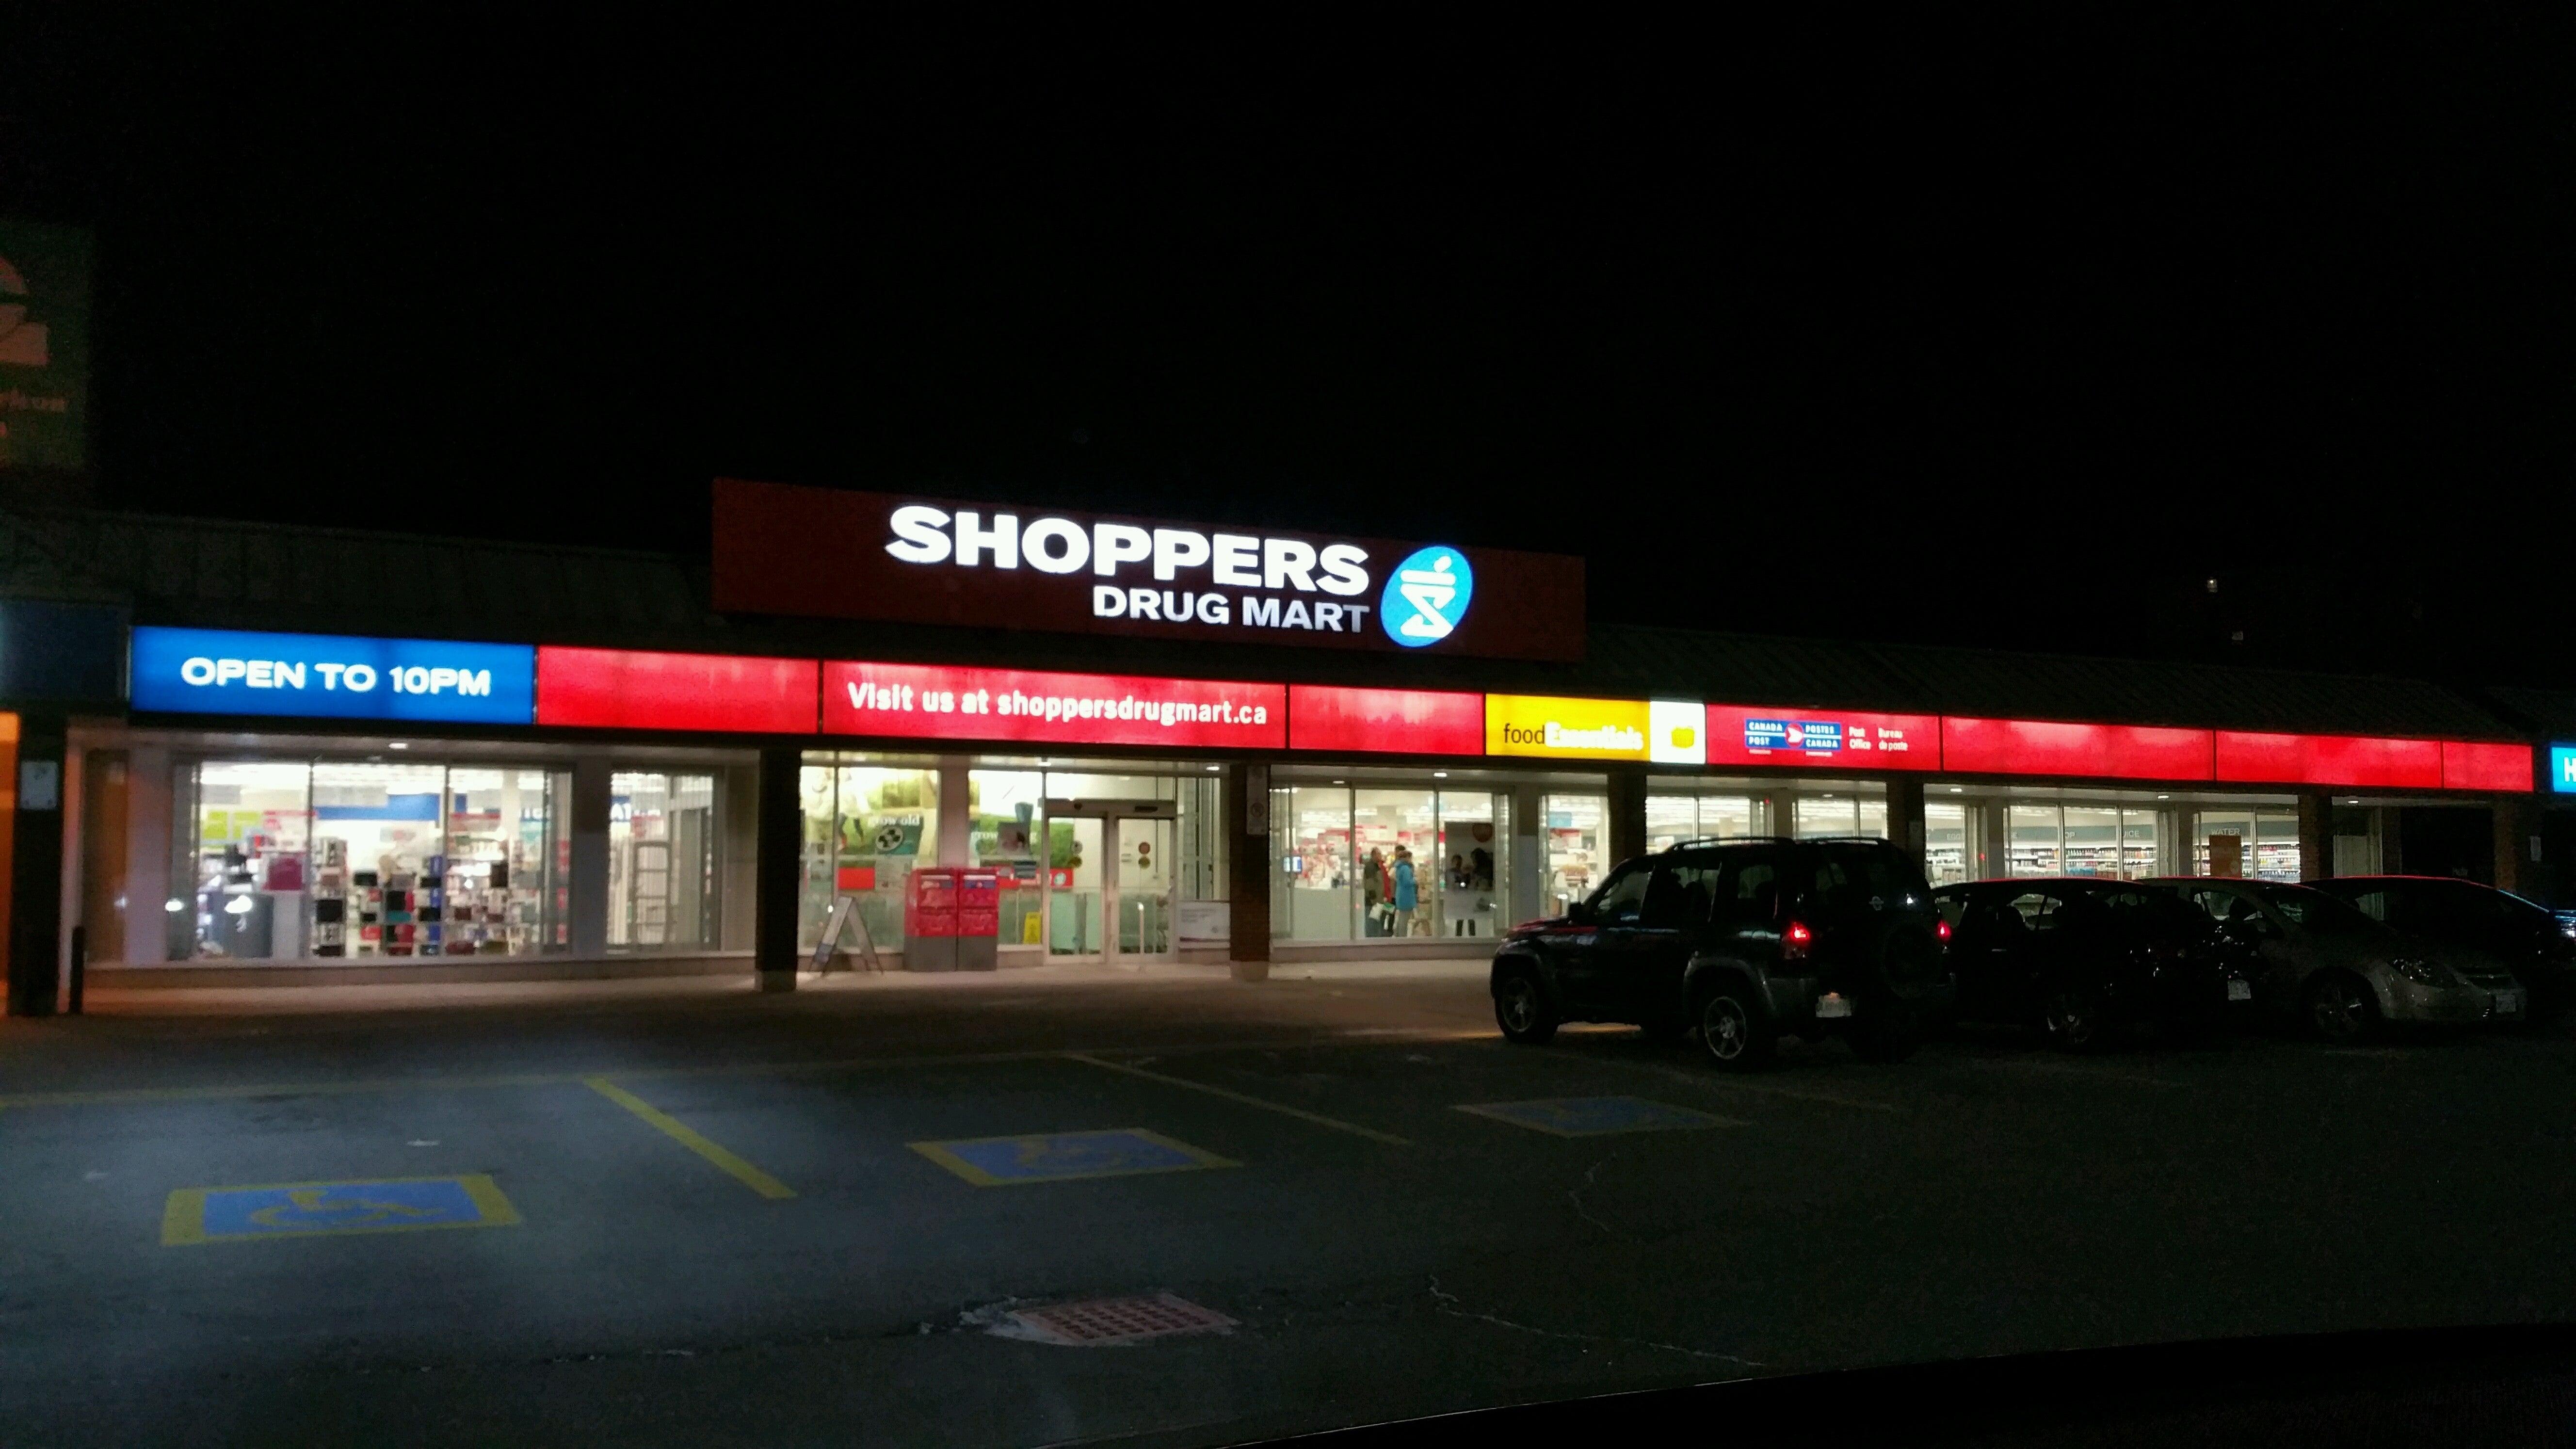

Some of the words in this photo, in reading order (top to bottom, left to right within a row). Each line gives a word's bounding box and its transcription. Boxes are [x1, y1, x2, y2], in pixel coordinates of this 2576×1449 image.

[885, 506, 1369, 595] SHOPPERS
[1094, 585, 1230, 625] DRUG
[1242, 596, 1369, 633] MART
[181, 657, 306, 690] OPEN
[315, 663, 377, 692] TO
[389, 666, 491, 696] 10PM
[848, 682, 913, 711] Visit
[922, 692, 954, 713] us
[961, 689, 989, 714] at
[998, 690, 1267, 726] shoppersdrugmart.ca
[1749, 722, 1783, 731] CANADA
[1749, 736, 1770, 745] POST
[1849, 726, 1866, 737] Post
